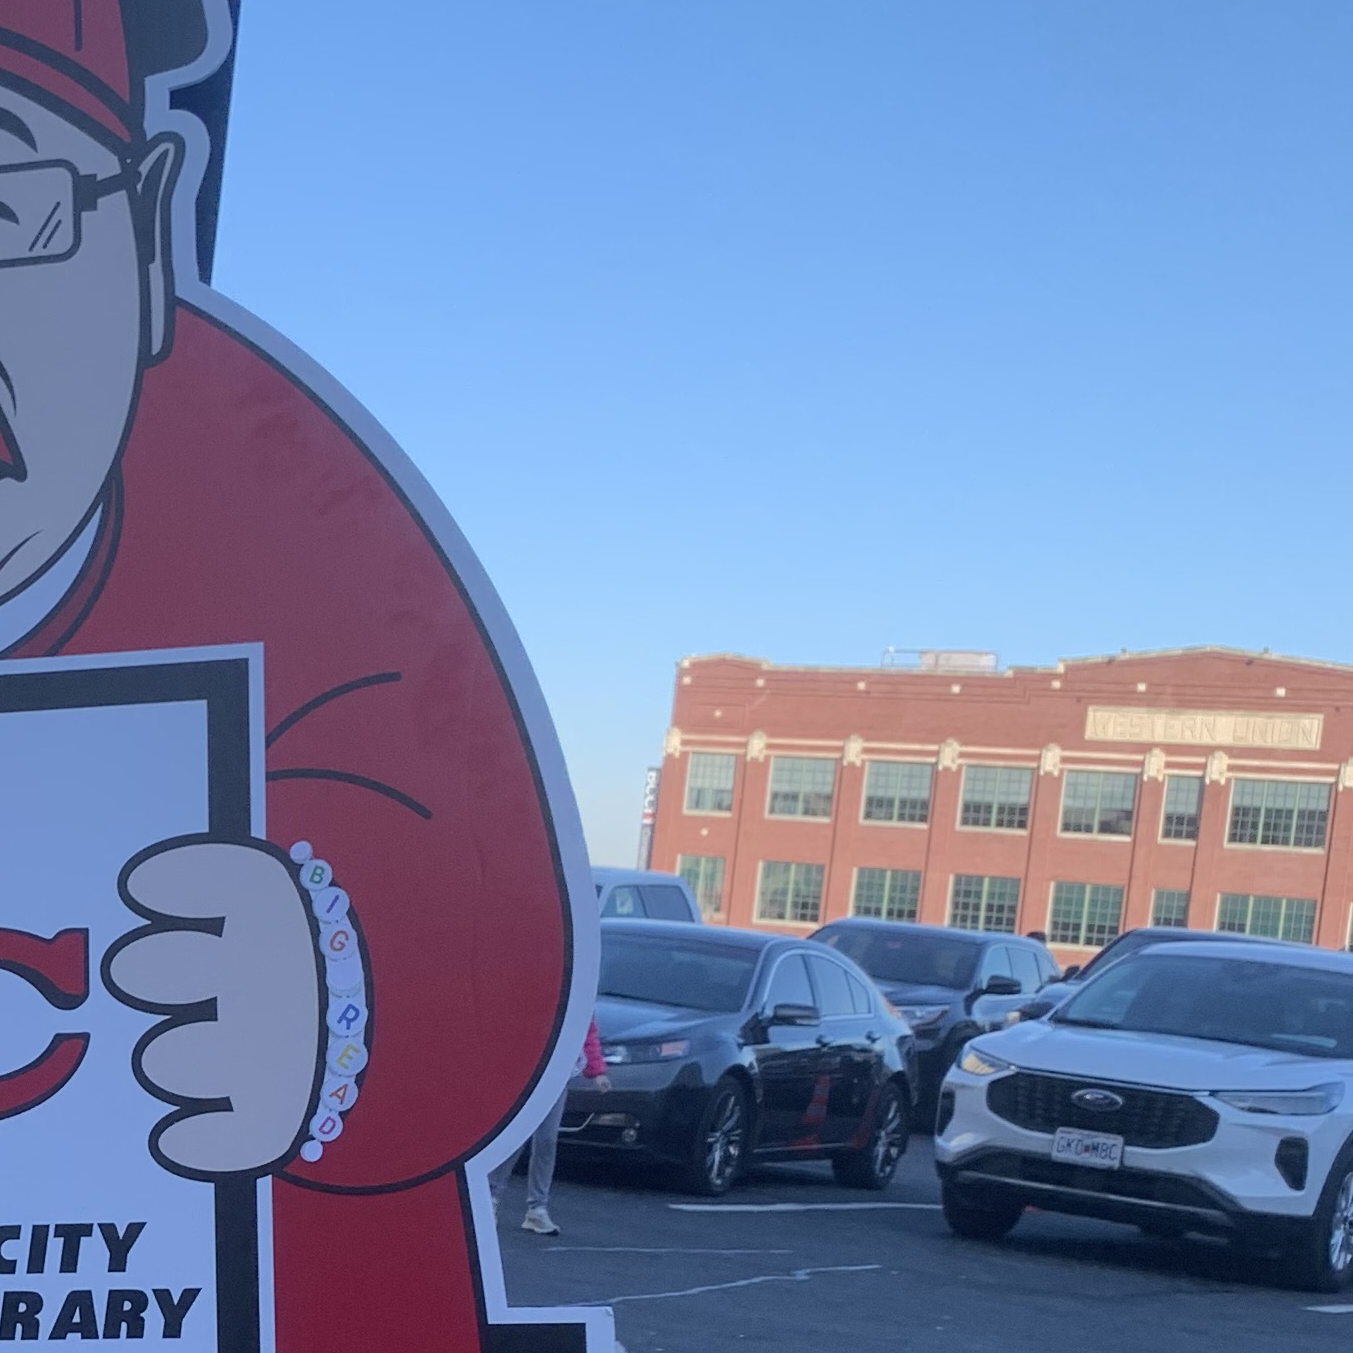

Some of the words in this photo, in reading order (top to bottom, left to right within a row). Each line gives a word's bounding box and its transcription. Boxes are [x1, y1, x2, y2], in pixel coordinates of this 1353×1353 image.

[1093, 707, 1218, 742] WESTERN
[1231, 715, 1316, 747] UNION
[308, 864, 350, 953] BIG
[318, 1002, 361, 1134] READ
